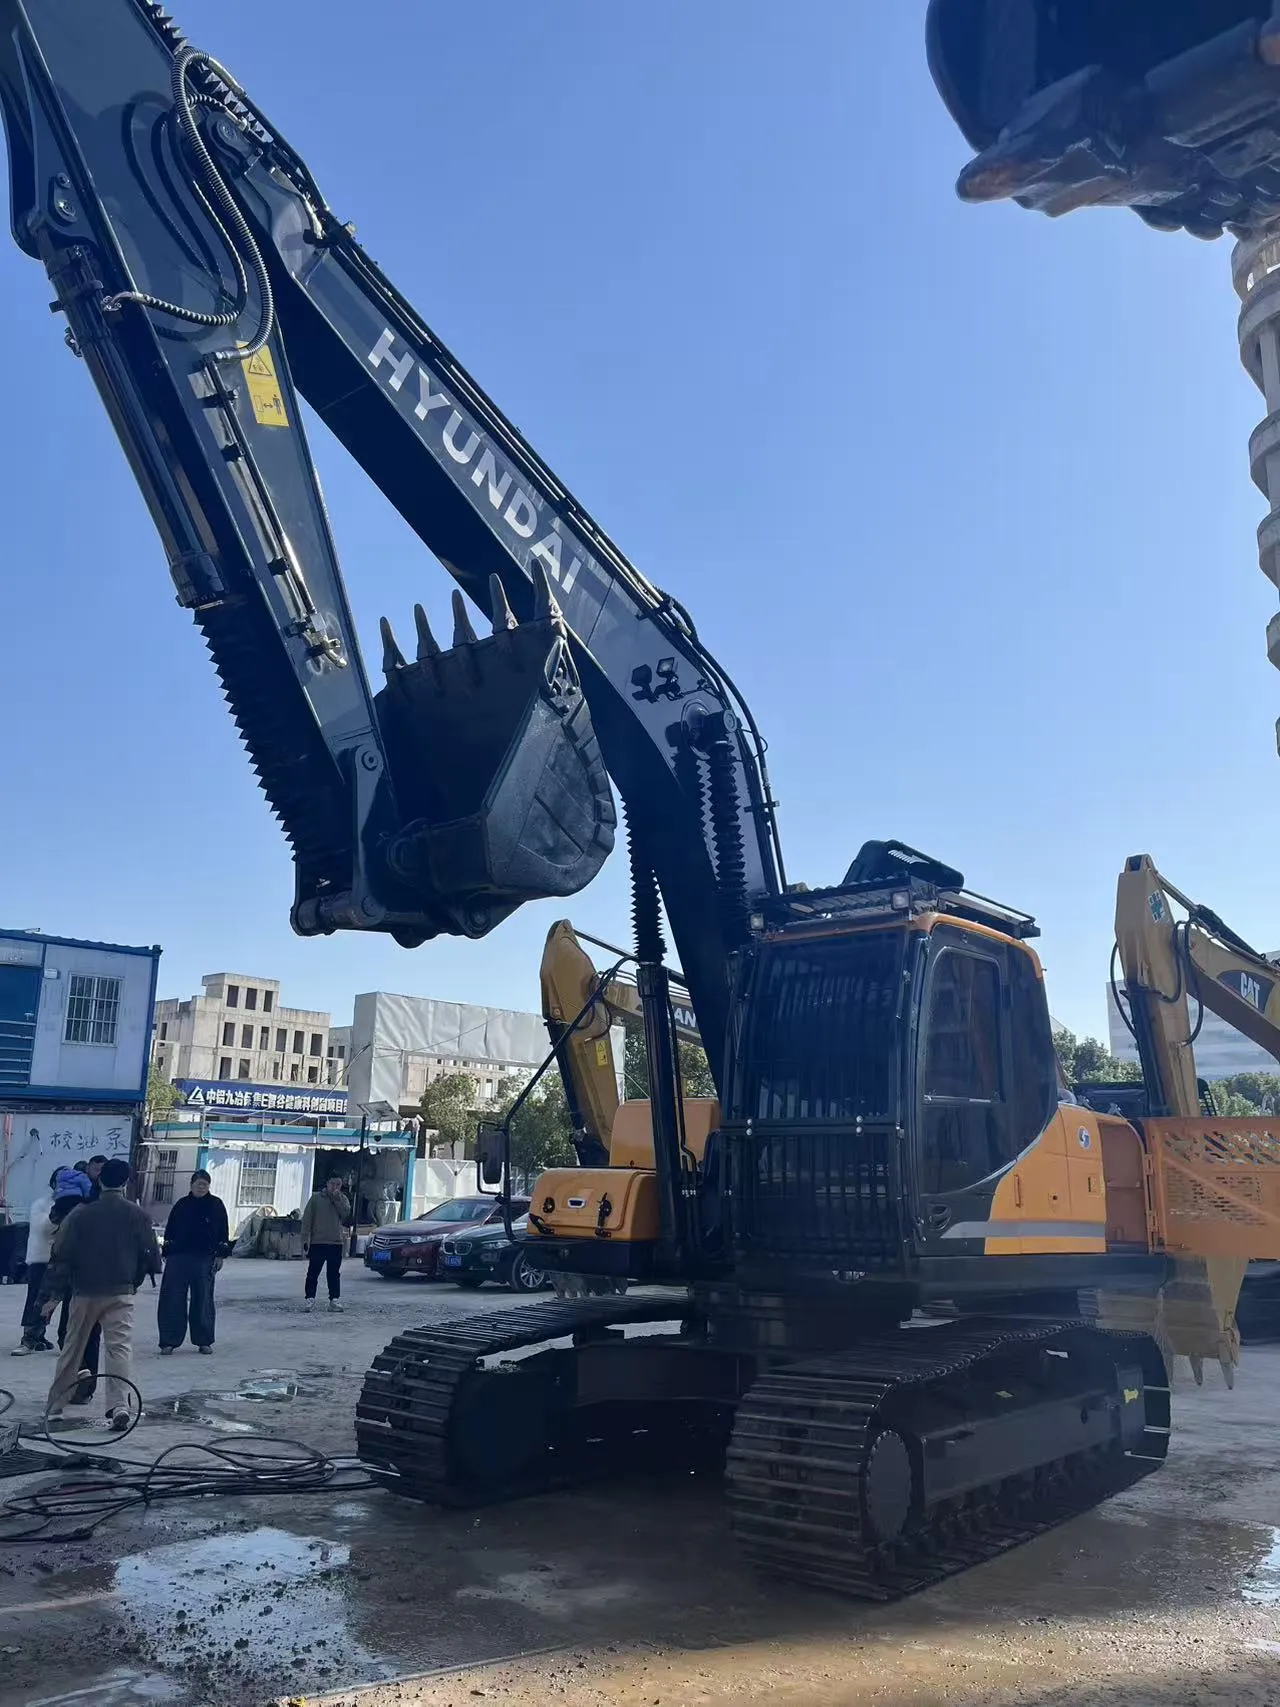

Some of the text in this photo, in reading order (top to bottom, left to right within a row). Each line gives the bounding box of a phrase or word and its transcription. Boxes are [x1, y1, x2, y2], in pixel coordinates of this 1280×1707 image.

[367, 327, 585, 594] HYUNDAI
[1241, 972, 1260, 1009] CAT
[674, 1007, 697, 1028] AN
